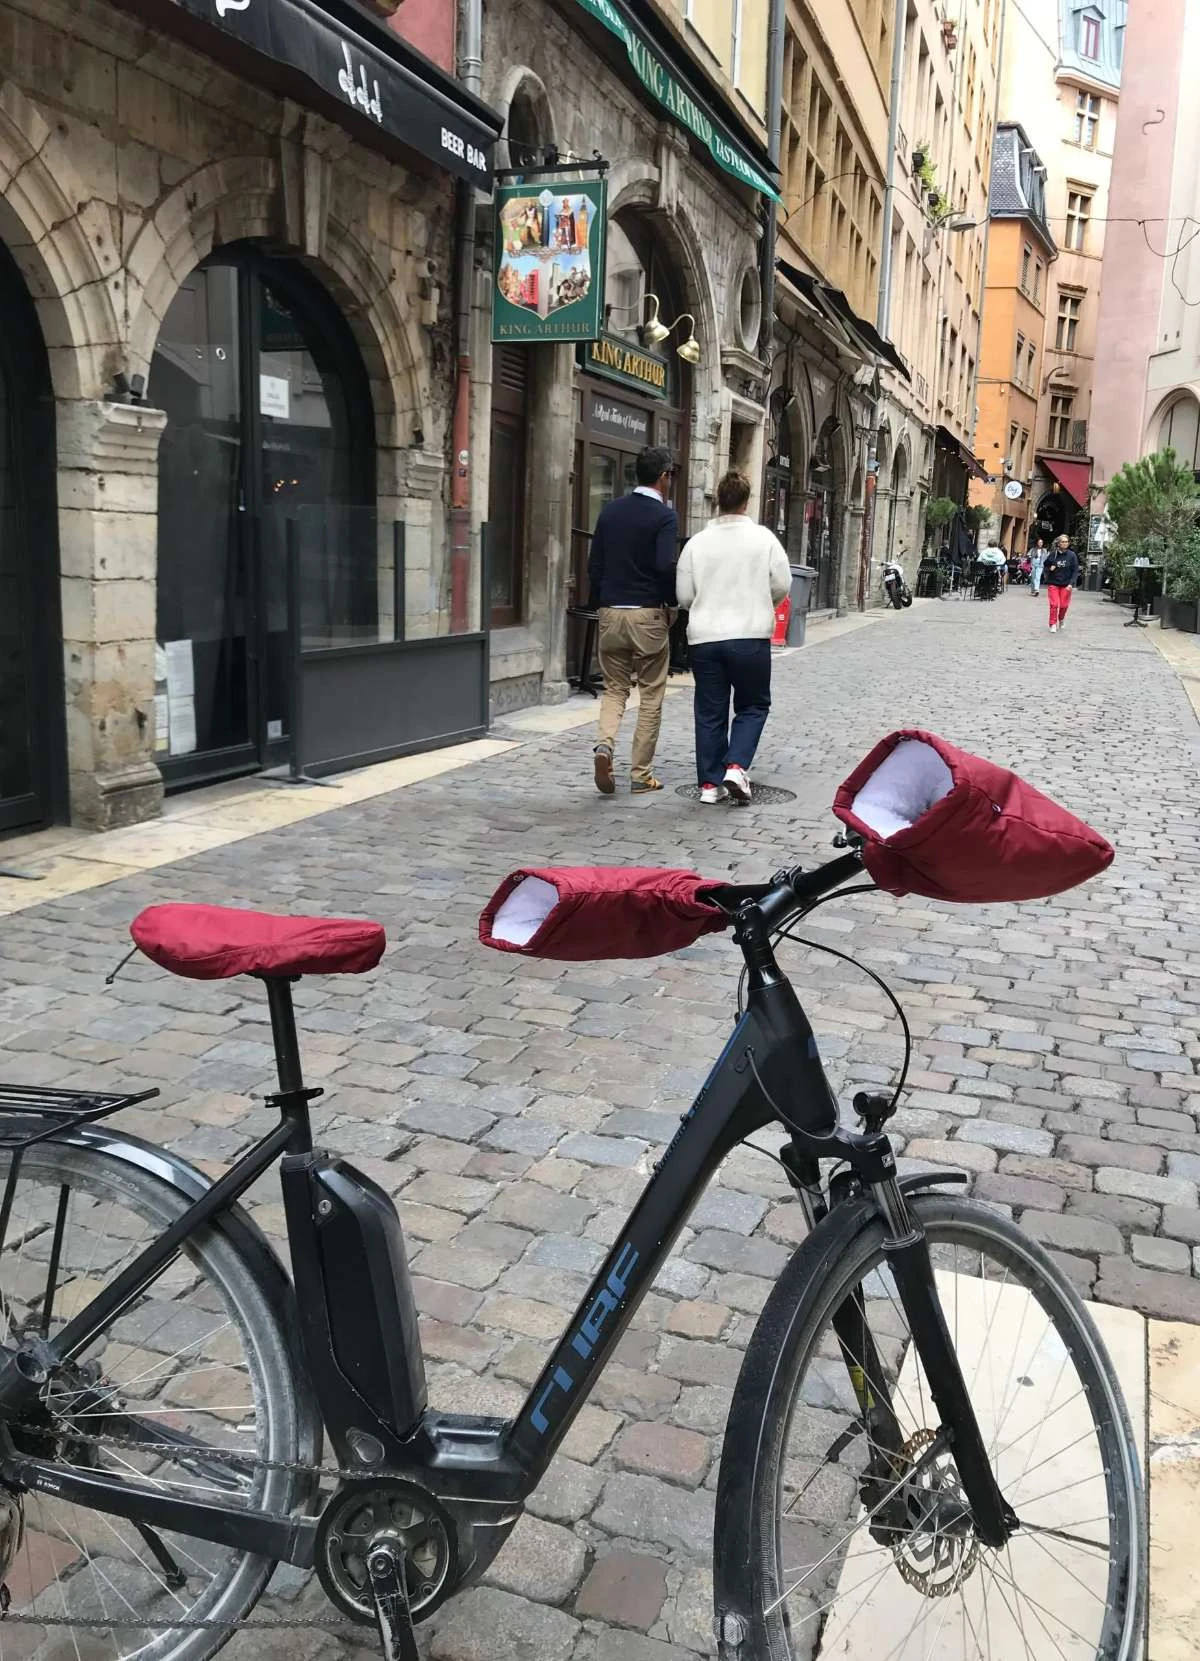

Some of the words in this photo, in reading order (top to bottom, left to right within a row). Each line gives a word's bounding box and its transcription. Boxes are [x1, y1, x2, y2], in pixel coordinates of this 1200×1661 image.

[631, 32, 664, 98] KING
[440, 126, 465, 159] BEER
[466, 143, 487, 172] BAR
[499, 323, 530, 336] KING
[535, 322, 590, 335] ARTHUR
[591, 341, 622, 370] KING
[623, 351, 665, 387] ARTHUR
